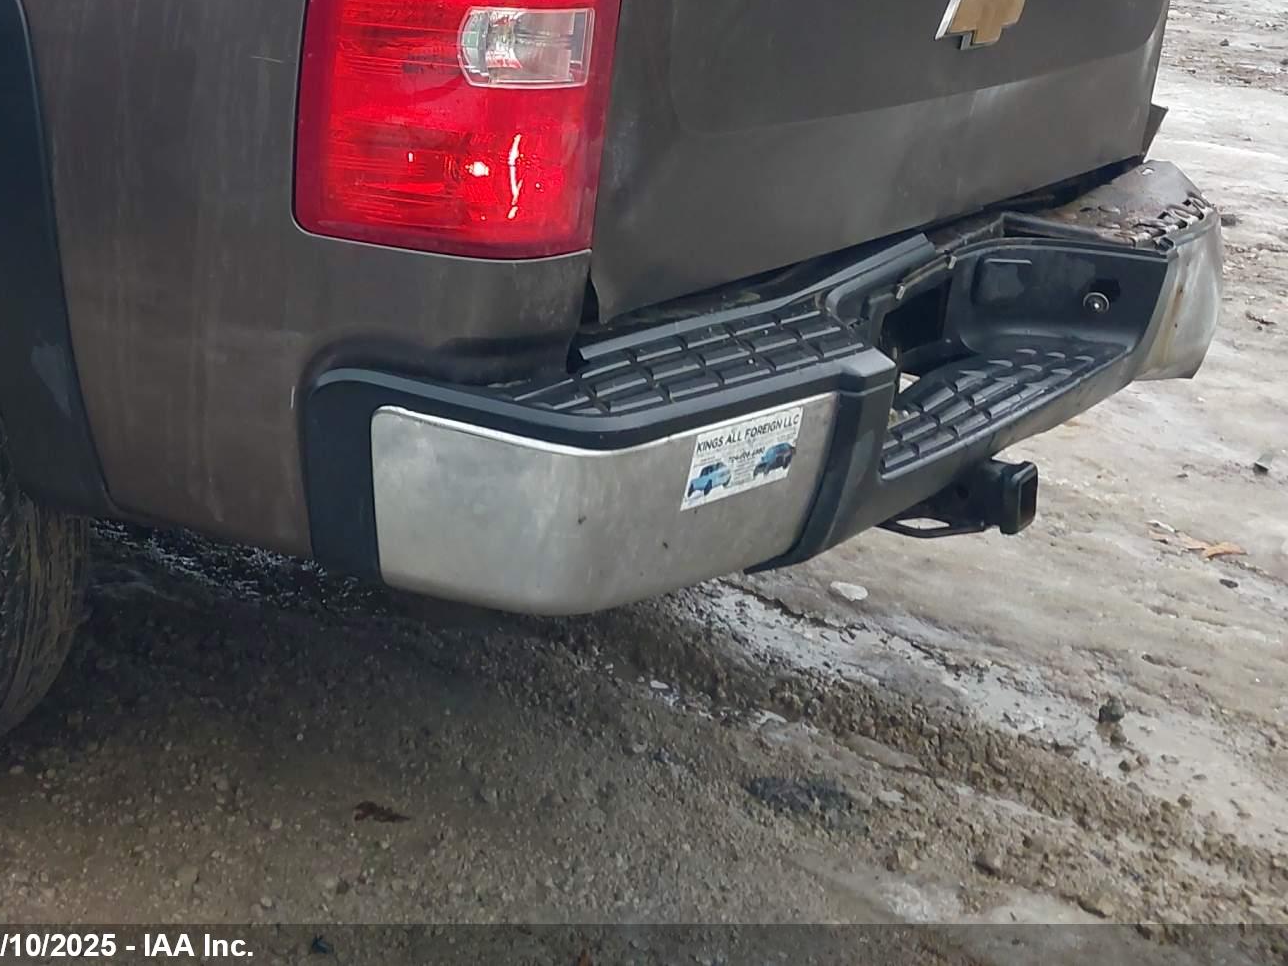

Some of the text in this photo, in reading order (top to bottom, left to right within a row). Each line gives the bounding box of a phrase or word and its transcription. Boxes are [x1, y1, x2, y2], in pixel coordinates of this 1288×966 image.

[696, 436, 724, 453] KINGS
[725, 430, 742, 444] ALL
[745, 420, 783, 438] FOREIGN
[783, 414, 800, 427] LLC
